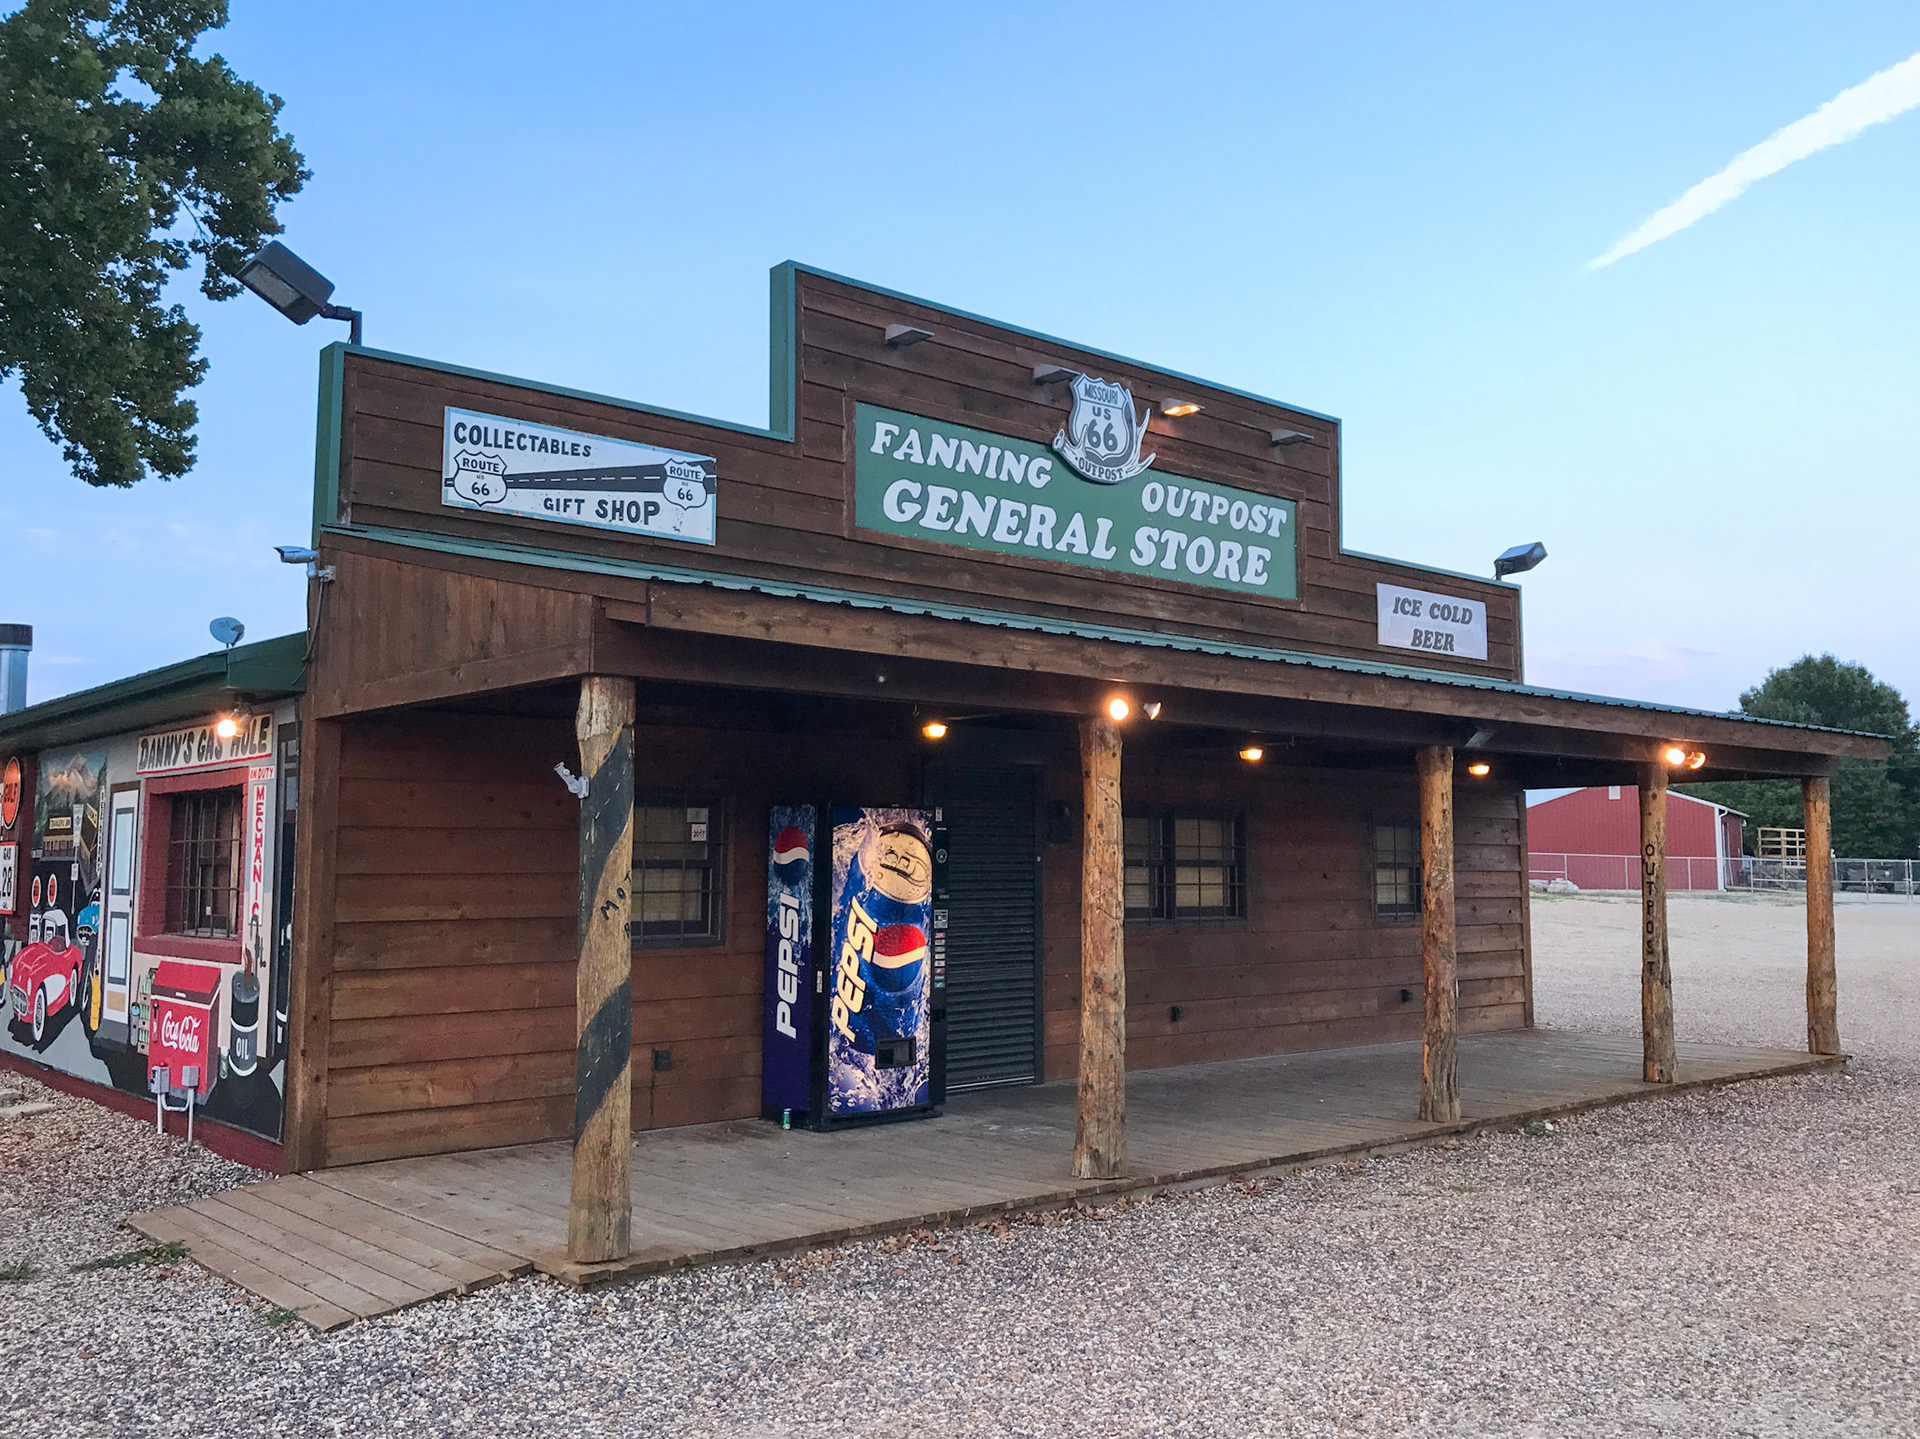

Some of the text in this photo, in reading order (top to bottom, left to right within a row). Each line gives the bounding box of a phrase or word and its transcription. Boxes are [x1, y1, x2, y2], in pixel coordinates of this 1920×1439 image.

[1084, 383, 1118, 405] MISSOURI
[1092, 405, 1112, 421] US
[453, 421, 592, 458] COLLECTABLES
[1087, 418, 1118, 452] 66
[462, 457, 500, 473] ROUTE
[669, 465, 701, 480] ROUTE
[1079, 456, 1124, 481] OUTPOST
[471, 481, 490, 496] 66
[869, 421, 1288, 538] FANNING OUTPOST
[677, 487, 693, 501] 66
[543, 497, 661, 525] GIFT SHOP
[881, 478, 1272, 586] GENERAL STORE
[1392, 596, 1473, 625] ICE COLD
[1411, 628, 1455, 652] BEER
[138, 731, 195, 770] DANNY'S
[197, 726, 223, 763] GAS
[250, 766, 274, 779] ON DUTY
[1644, 843, 1656, 975] OUTPOST
[776, 892, 800, 1039] PEPSI
[831, 896, 878, 1042] PEPSI
[235, 1037, 250, 1060] OIL
